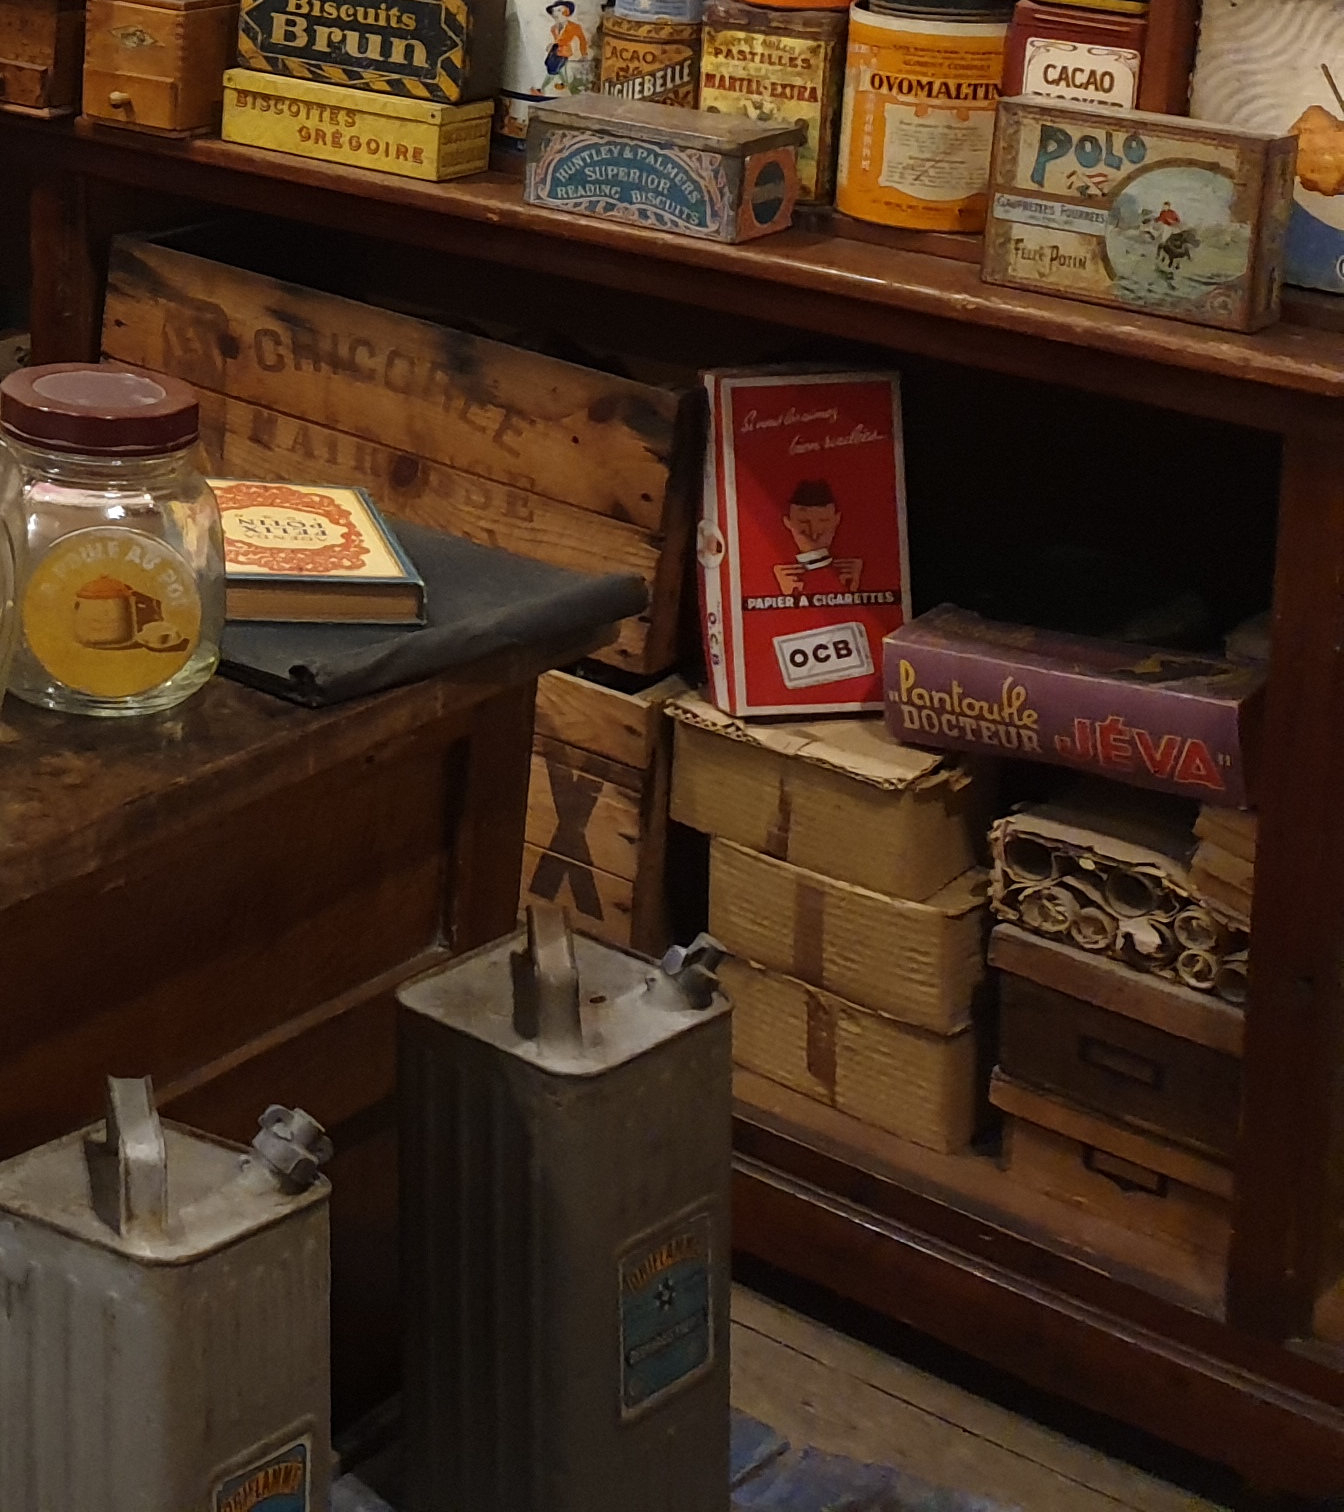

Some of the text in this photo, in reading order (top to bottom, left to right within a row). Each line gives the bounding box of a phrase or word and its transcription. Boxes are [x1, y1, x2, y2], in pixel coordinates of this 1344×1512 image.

[270, 13, 429, 68] Brun
[713, 46, 812, 70] PASTILLES
[1043, 62, 1116, 90] CACAO
[235, 90, 357, 128] BISCOTTES
[298, 124, 425, 166] GRÉGOIRE
[584, 165, 671, 194] SUPERIOR
[556, 184, 700, 226] READING BISCUITS
[746, 590, 895, 610] PAPIER CIGARETTES
[788, 639, 854, 668] OCB
[902, 707, 1042, 754] DOCTEUR
